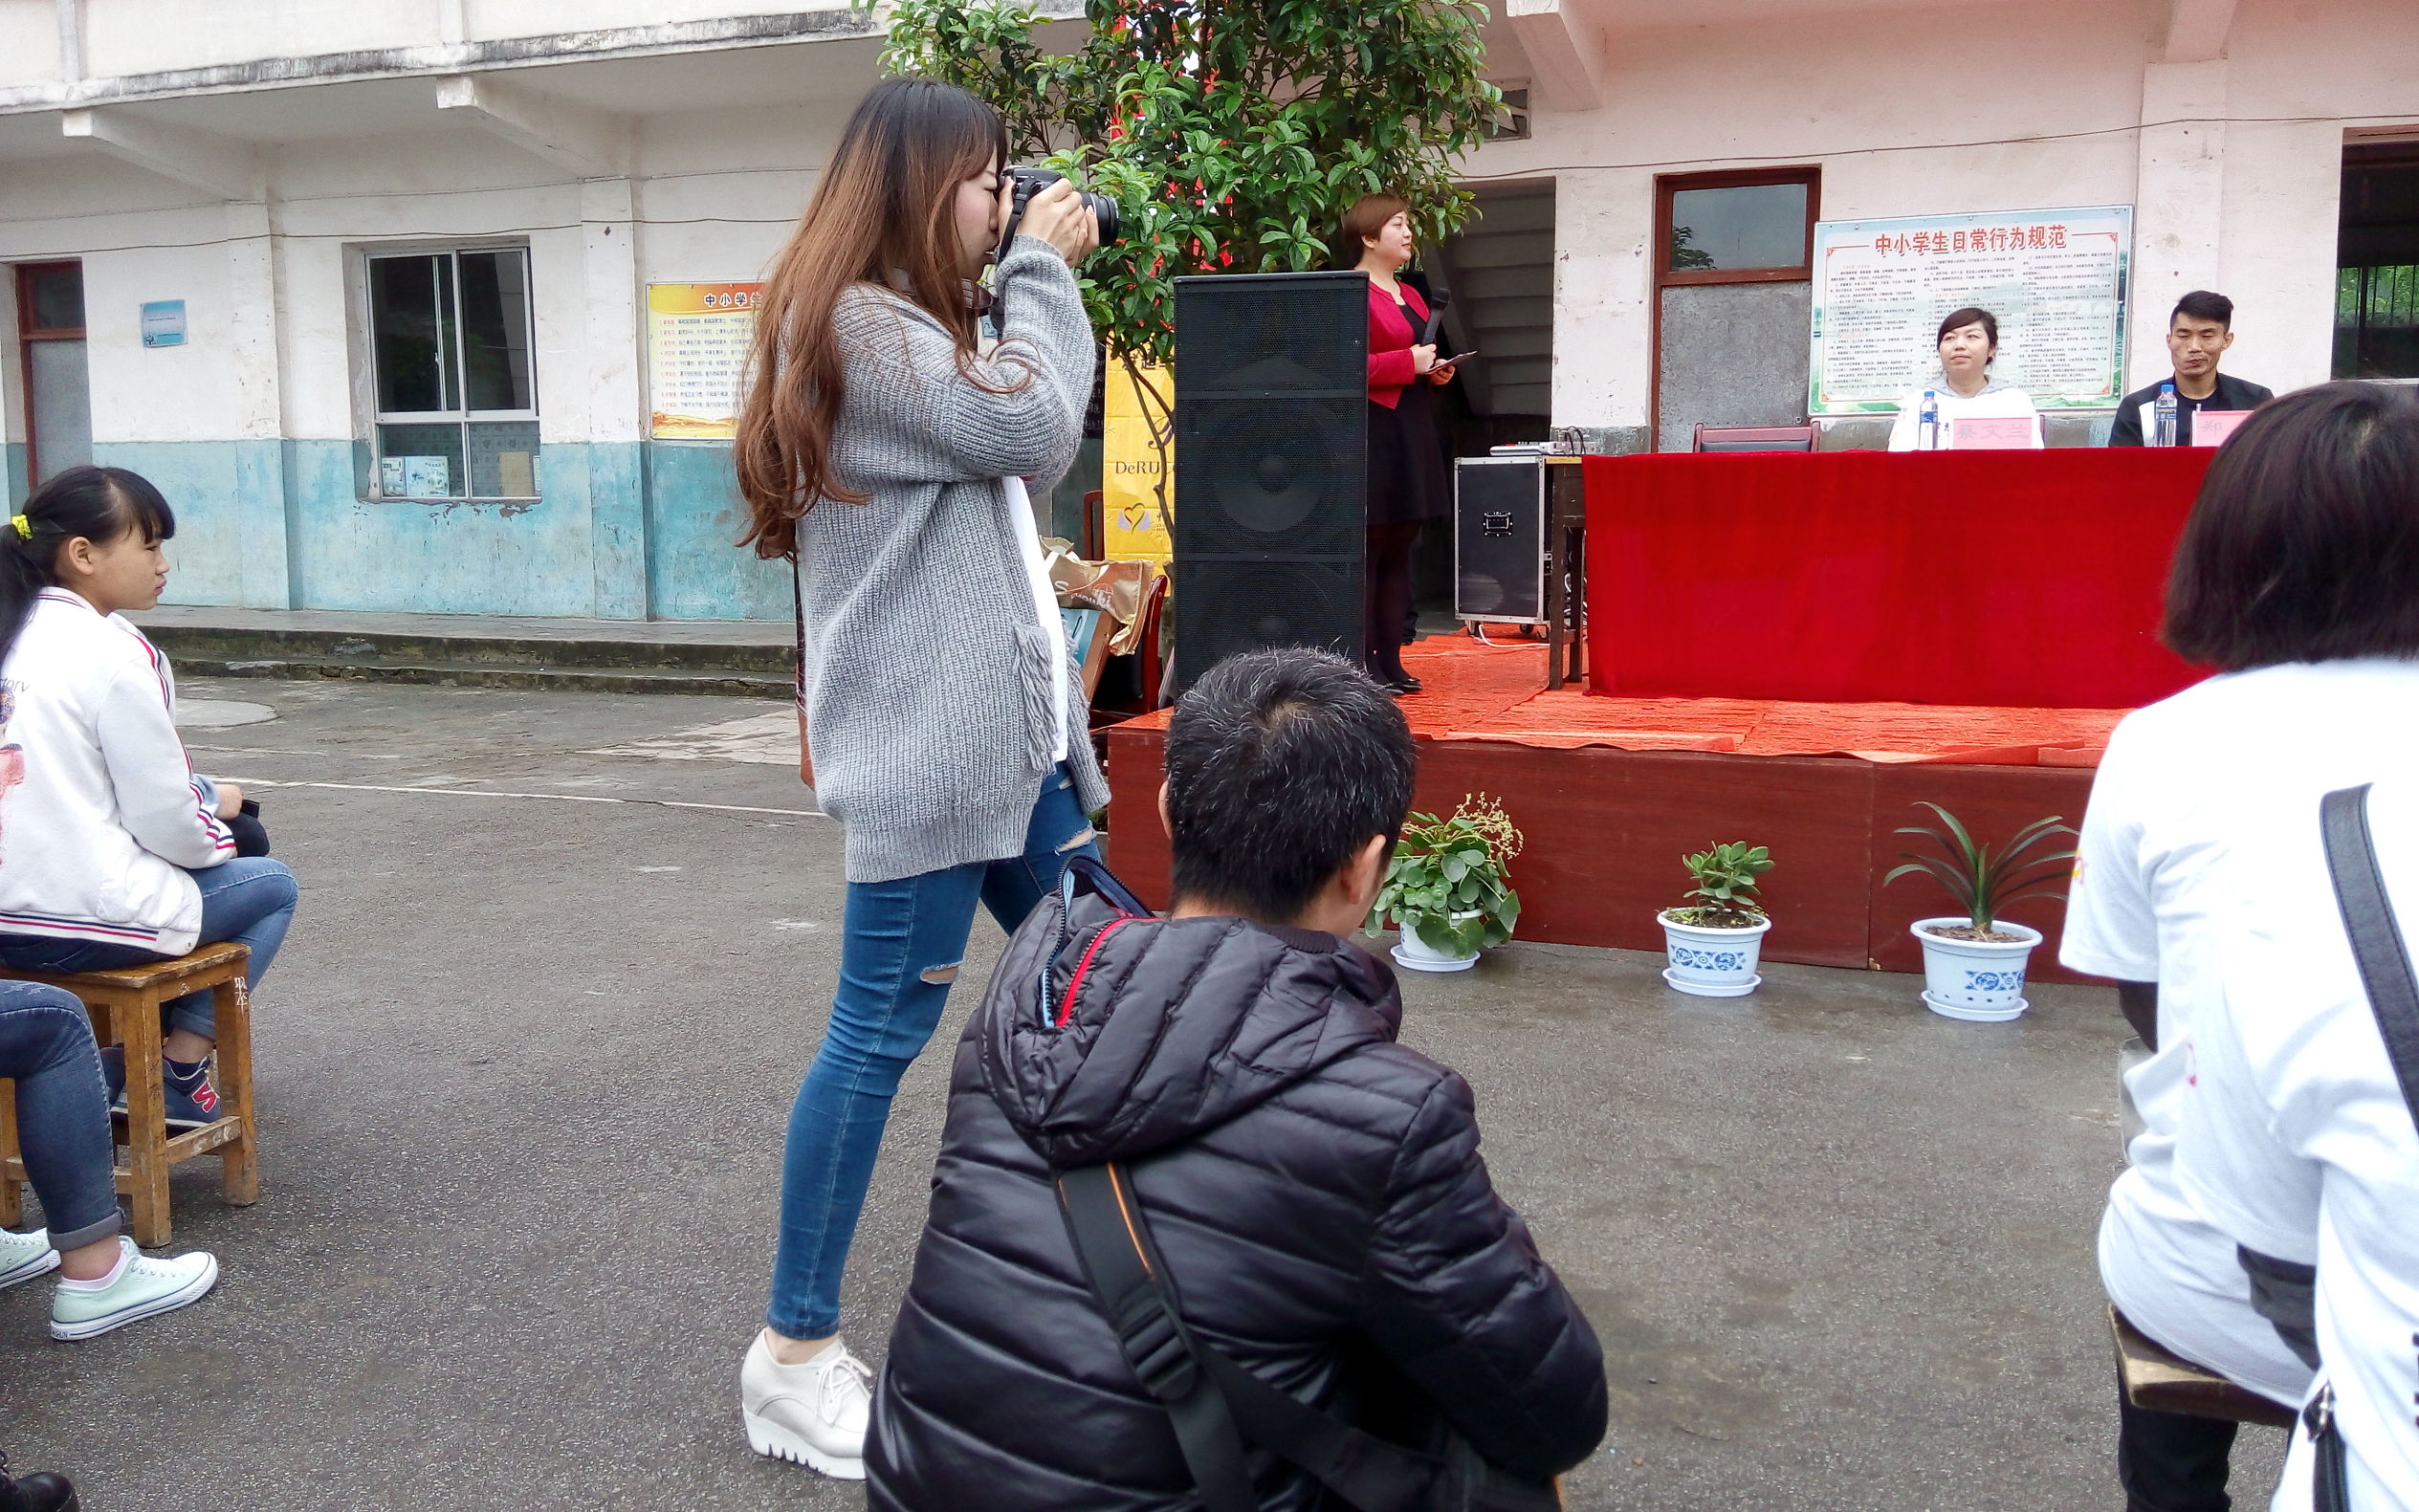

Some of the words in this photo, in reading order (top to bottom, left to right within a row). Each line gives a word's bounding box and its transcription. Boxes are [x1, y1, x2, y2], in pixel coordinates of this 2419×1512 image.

[1875, 224, 2067, 256] 中小学生日常行为规范
